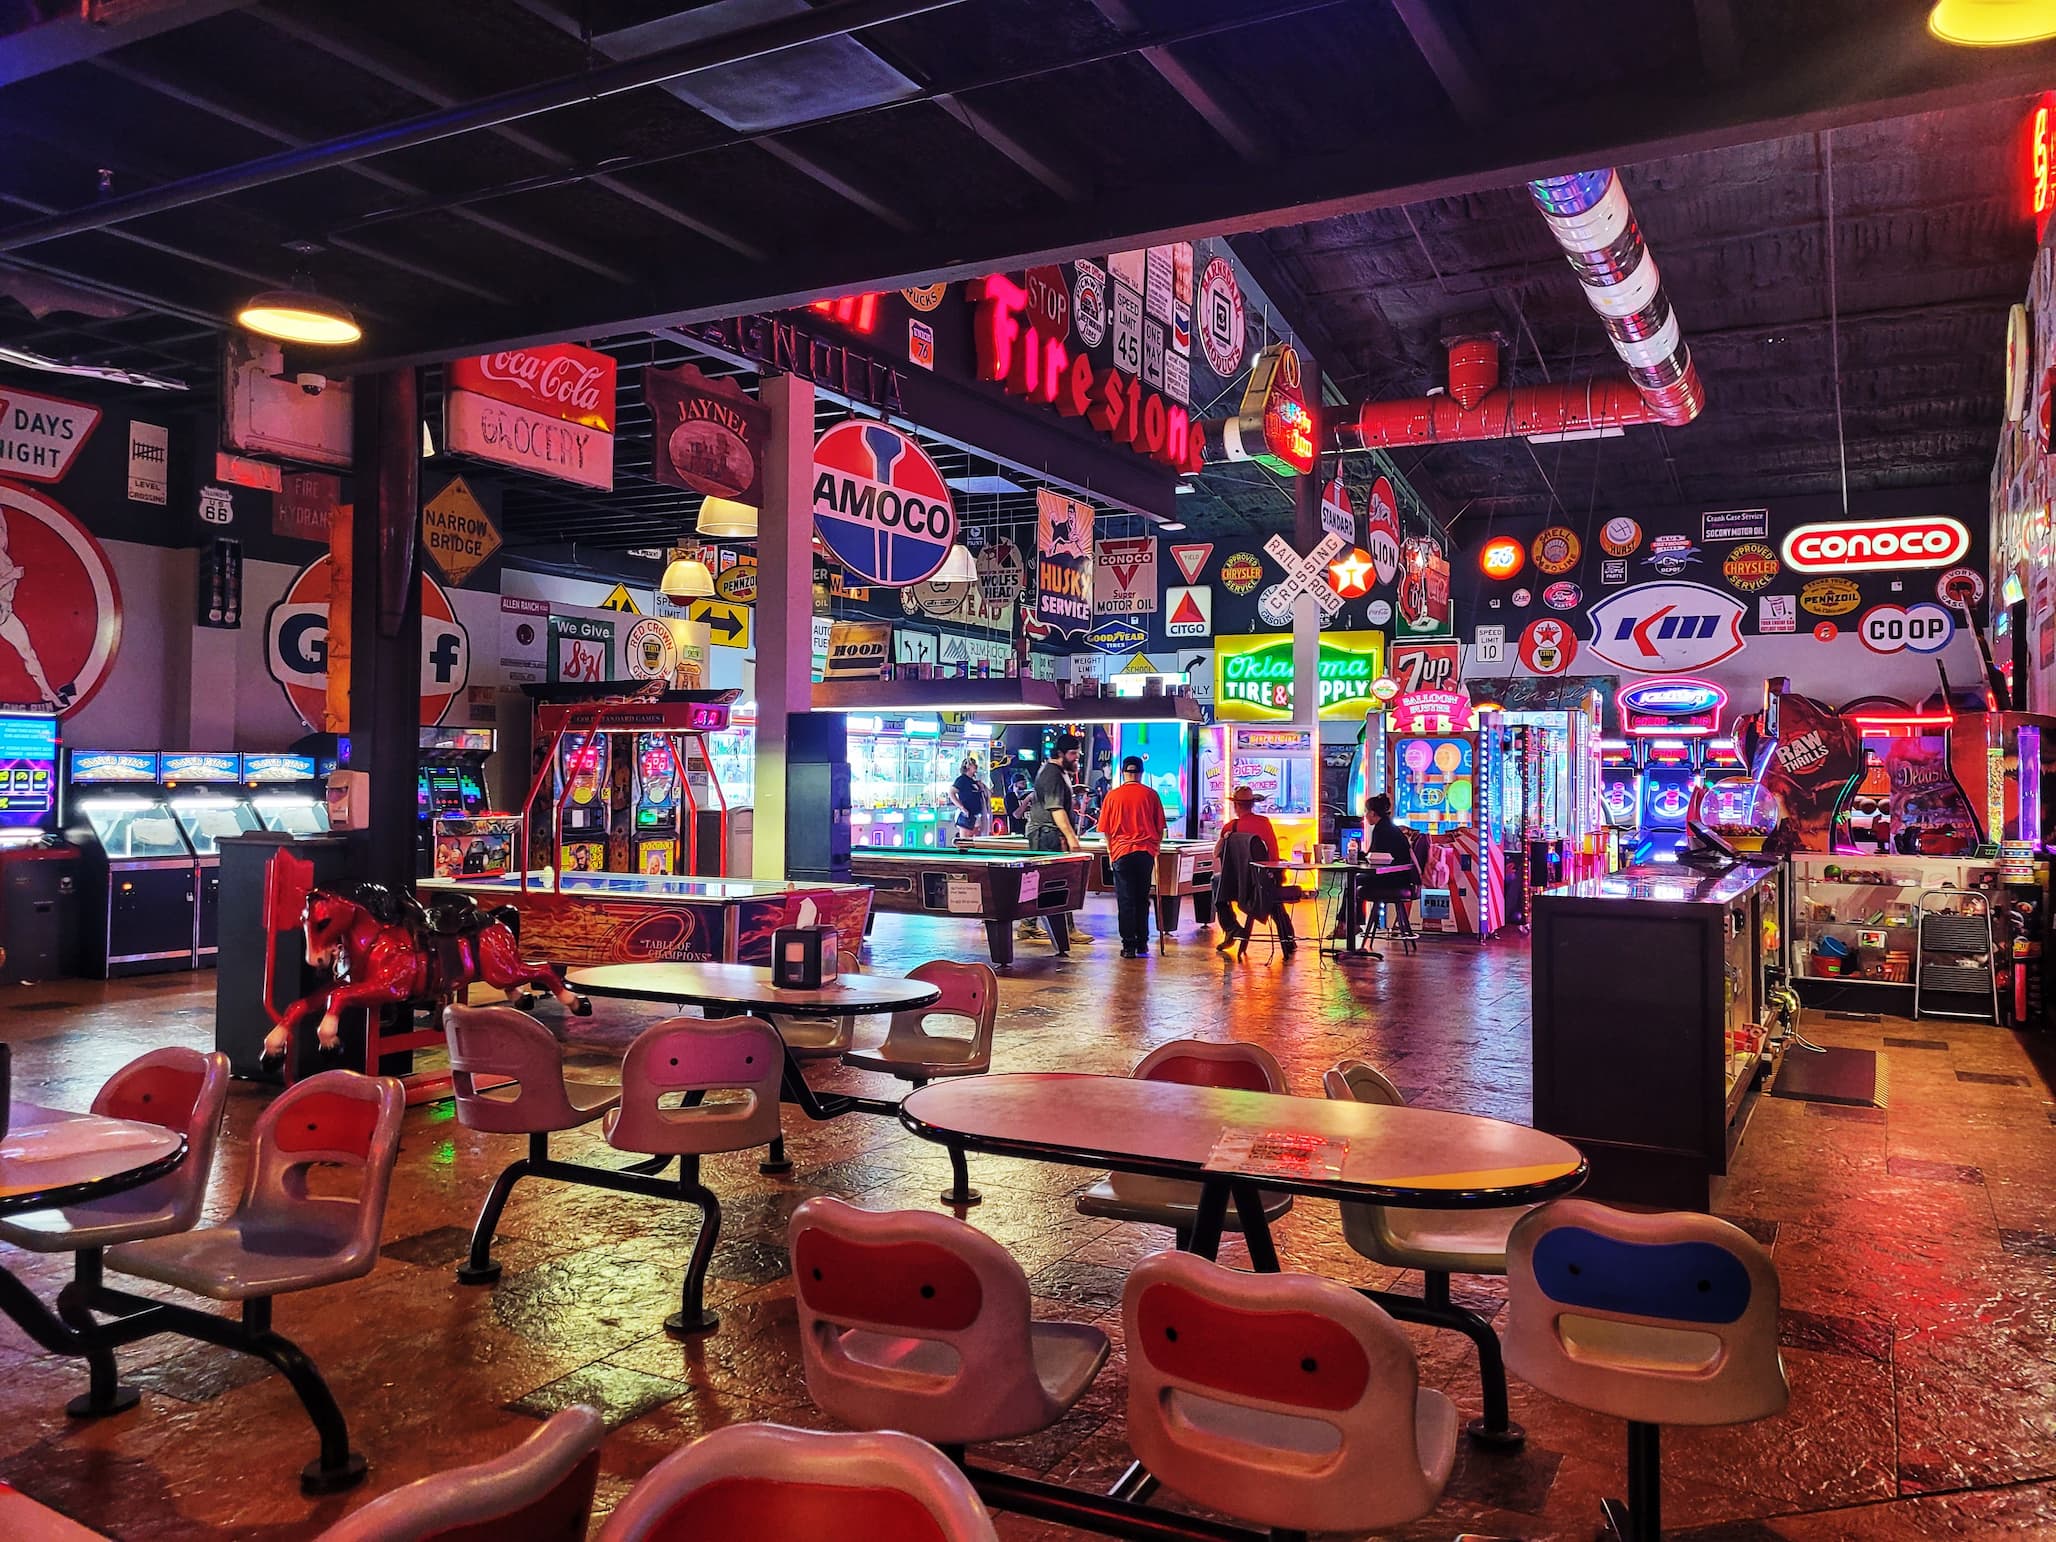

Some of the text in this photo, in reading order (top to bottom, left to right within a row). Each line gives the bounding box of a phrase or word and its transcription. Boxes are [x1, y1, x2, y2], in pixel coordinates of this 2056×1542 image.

[1202, 257, 1241, 319] BARNSDALL
[1028, 277, 1067, 323] STOP
[1118, 293, 1140, 317] SPEED
[1119, 312, 1137, 331] LIMIT
[1146, 325, 1161, 346] ONE
[918, 342, 929, 358] 76
[1118, 331, 1138, 367] 45
[1145, 343, 1161, 364] WAY
[1203, 324, 1240, 374] PRODUCTS
[480, 351, 606, 410] Coca-Cola
[975, 272, 1206, 473] Firestone
[15, 408, 74, 440] DAYS
[482, 408, 589, 469] GROCERY
[134, 480, 161, 491] LEVEL
[295, 479, 320, 498] FIRE
[205, 506, 227, 522] 66
[814, 472, 951, 540] AMOCO
[425, 510, 487, 538] NARROW
[1322, 509, 1354, 536] STANDARD
[1706, 513, 1764, 522] Crank Case Service
[1539, 528, 1571, 544] SHELL
[1705, 526, 1764, 538] SOCONY MOTOR OIL
[430, 533, 483, 557] BRIDGE
[1373, 538, 1395, 568] LION
[1730, 543, 1773, 562] APPROVED
[1101, 553, 1152, 565] CONOCO
[1225, 552, 1258, 569] APPROVED
[1723, 560, 1779, 575] CHRYSLER
[1040, 562, 1091, 598] HUSKY
[1221, 566, 1263, 580] CHRYSLER
[1268, 539, 1296, 570] RAIL
[1308, 578, 1341, 611] ROAD
[1271, 537, 1339, 609] CROSSING
[1945, 569, 1974, 580] IVORY
[1224, 579, 1257, 594] SERVICE
[1729, 574, 1772, 591] SERVICE
[1113, 590, 1136, 601] Super
[1804, 593, 1858, 605] PENNZOIL
[502, 599, 520, 610] ALLEN
[520, 600, 540, 612] RANCH
[659, 608, 681, 619] LIMIT
[1041, 595, 1090, 621] SERVICE
[1098, 599, 1154, 612] MOTOR OIL
[556, 620, 577, 634] We
[1170, 624, 1205, 635] CITGO
[630, 622, 674, 651] RED CROWN
[1087, 632, 1145, 643] GOODYEAR
[833, 643, 883, 657] HOOD
[1482, 645, 1497, 660] 10
[1074, 657, 1102, 665] WEIGHT
[1227, 654, 1369, 678] Oklama
[1190, 685, 1211, 695] NLY
[1226, 681, 1273, 706] TIRE
[1273, 685, 1287, 706] &
[1402, 692, 1459, 706] BALLOON
[602, 715, 635, 723] TANDARD
[1775, 729, 1824, 766] RAW
[1783, 744, 1830, 774] THRILLS
[680, 941, 692, 952] OF
